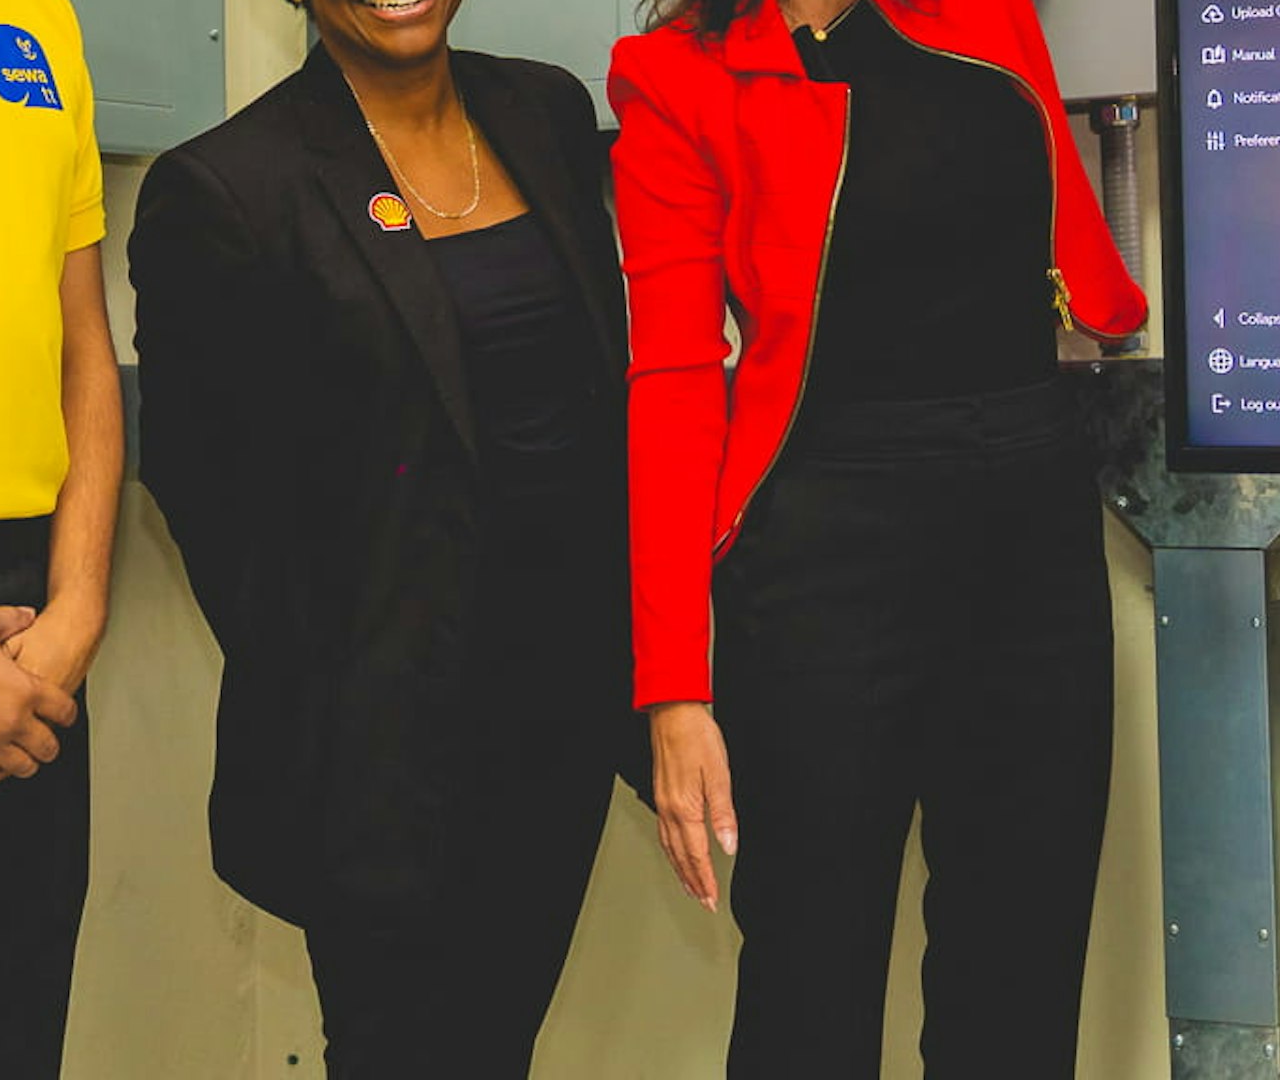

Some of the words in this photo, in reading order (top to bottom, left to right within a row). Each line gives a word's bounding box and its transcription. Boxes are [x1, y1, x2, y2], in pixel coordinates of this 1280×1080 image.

[1231, 4, 1274, 21] Upload
[1231, 47, 1276, 62] Manual
[1, 67, 49, 84] sewa
[40, 85, 59, 106] tt
[1240, 399, 1263, 413] Log
